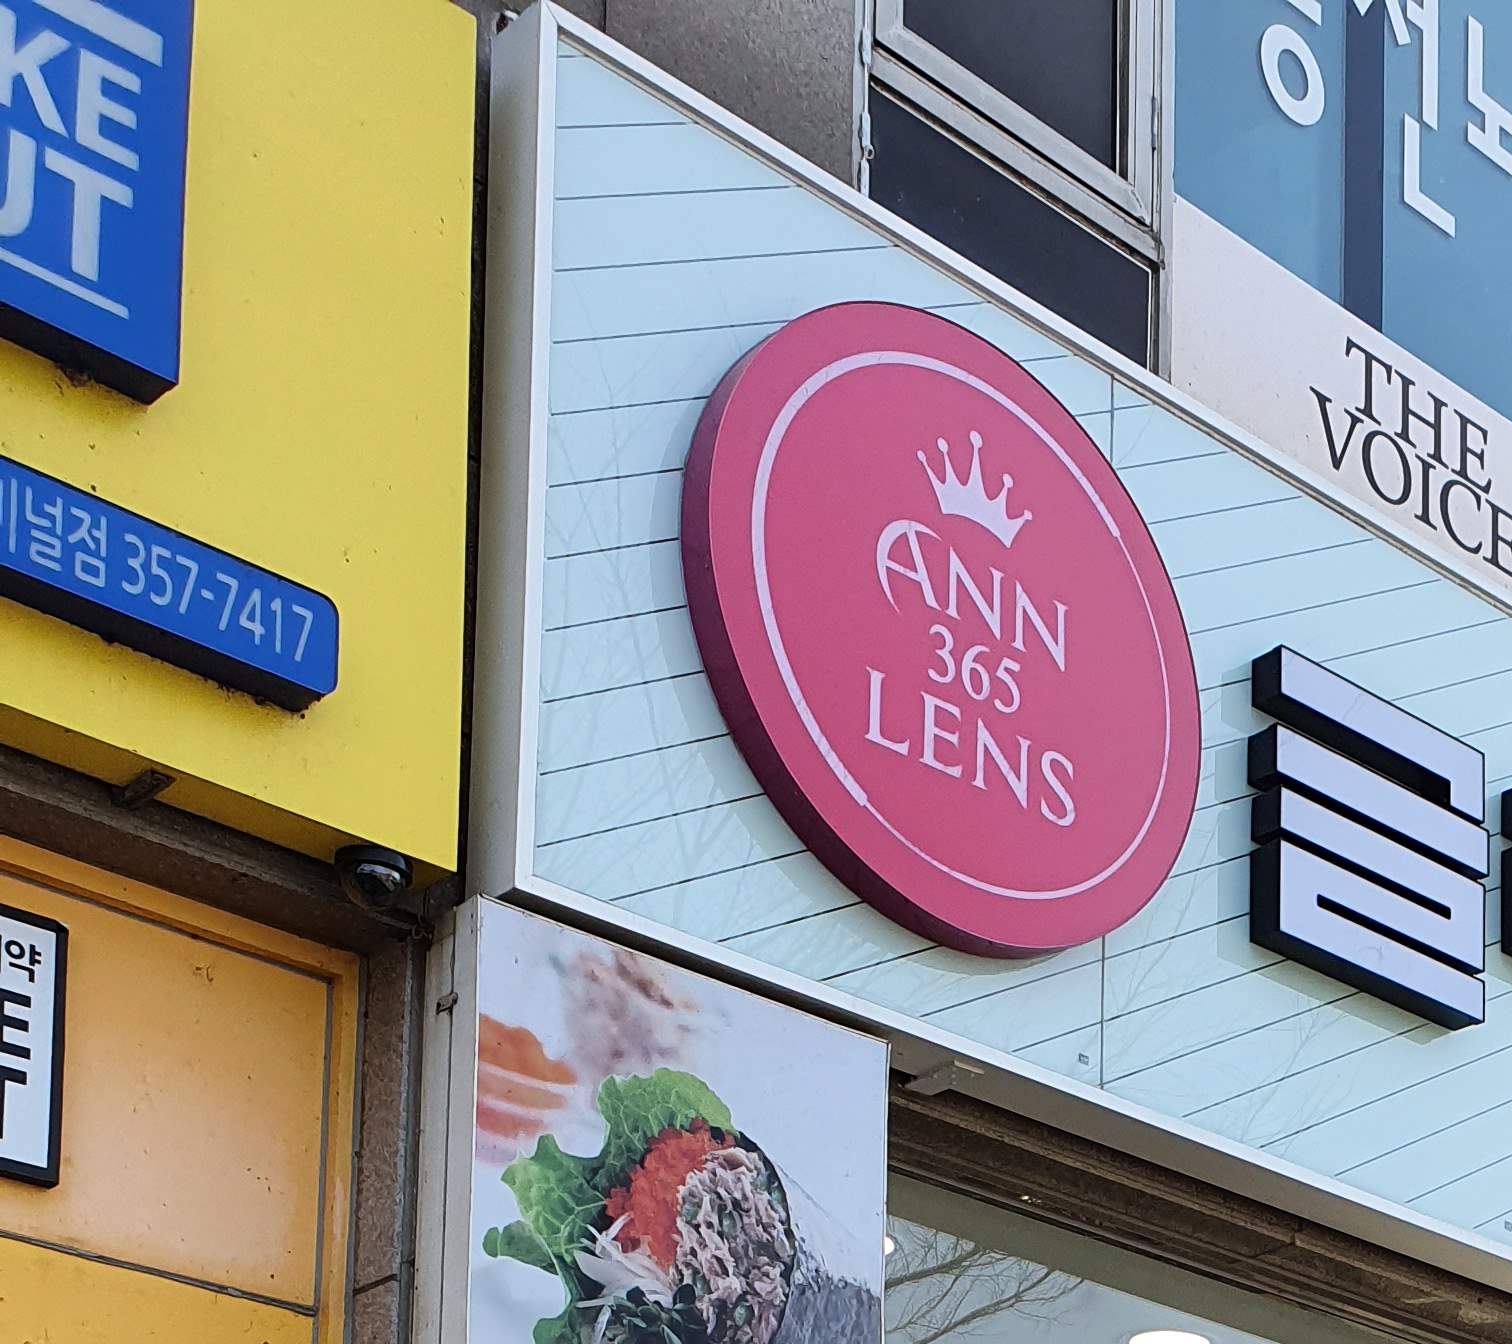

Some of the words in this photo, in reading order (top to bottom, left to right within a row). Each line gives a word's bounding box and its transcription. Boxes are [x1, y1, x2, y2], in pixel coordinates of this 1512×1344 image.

[1345, 335, 1492, 493] THE
[121, 533, 314, 662] 357-7417
[876, 518, 1068, 673] ANN
[927, 624, 1022, 714] 365
[864, 666, 1076, 828] LENS
